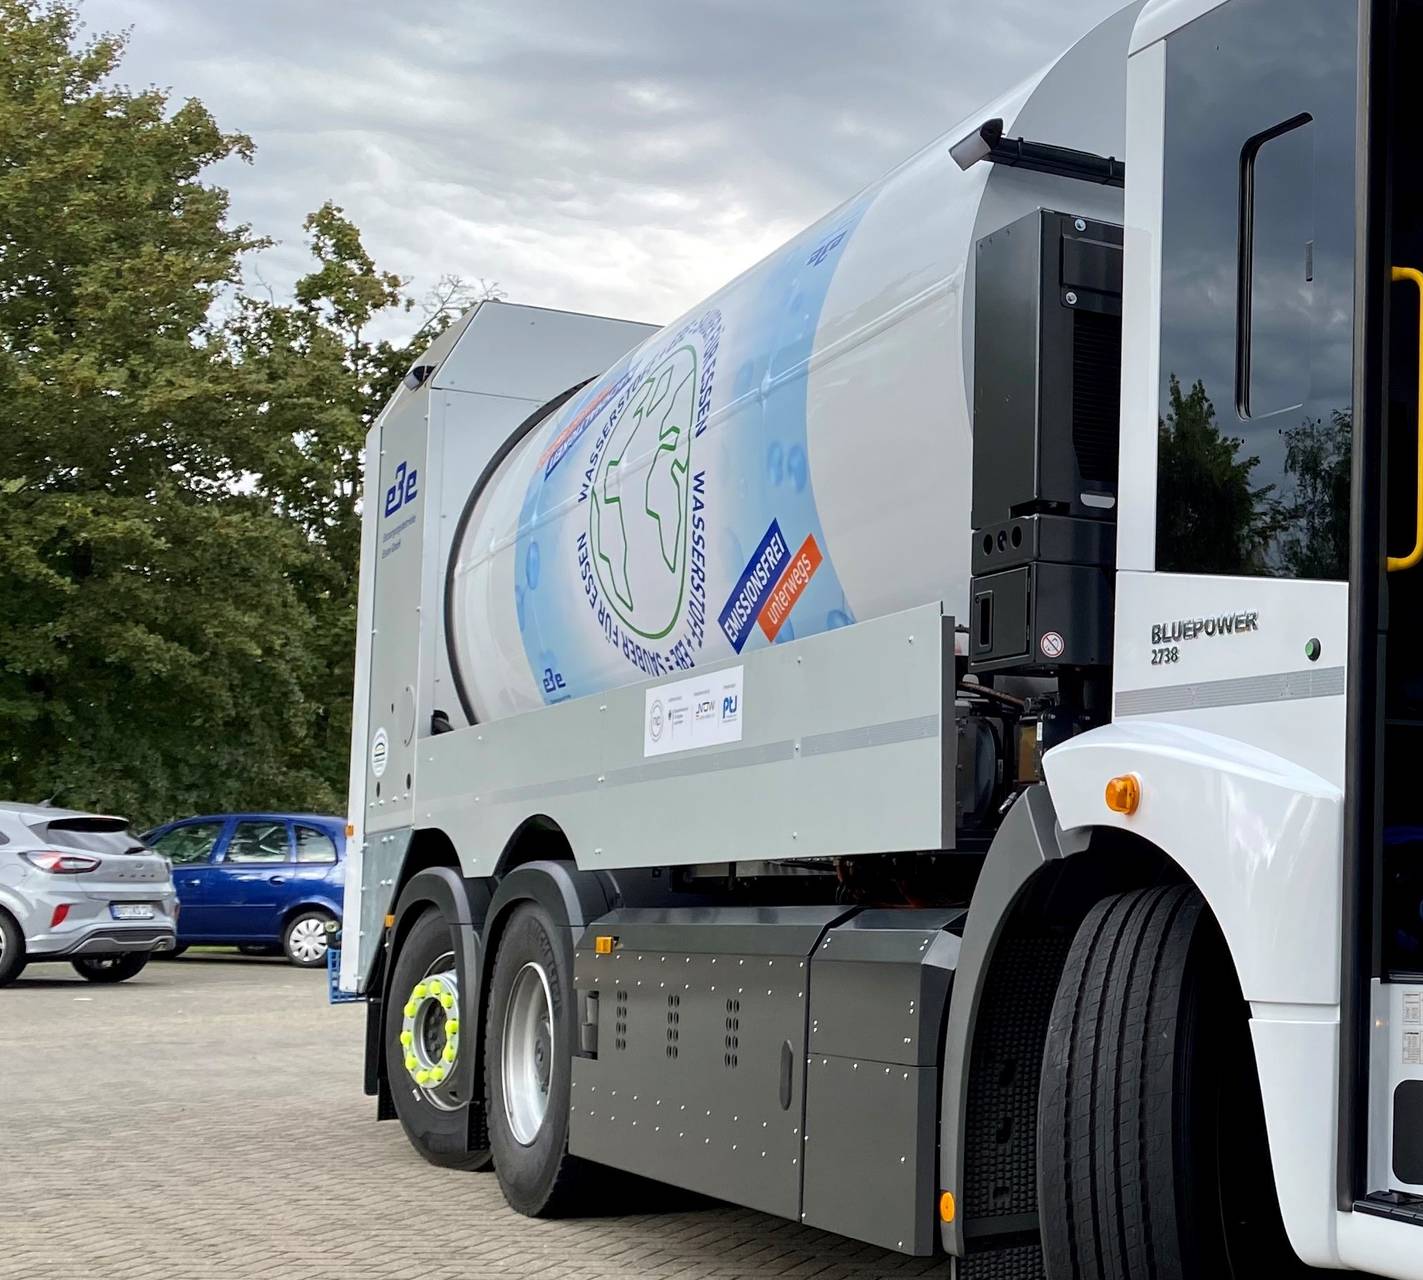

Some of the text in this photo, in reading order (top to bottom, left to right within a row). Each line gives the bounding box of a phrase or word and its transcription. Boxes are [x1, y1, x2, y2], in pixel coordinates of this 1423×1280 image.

[577, 532, 598, 609] ESSEN
[687, 471, 706, 648] WASSERSTOFF
[724, 532, 785, 643] EMISSIONSFREI
[767, 553, 811, 624] unterwegs
[598, 600, 618, 648] FÜR
[1151, 611, 1259, 645] BLUEPOWER
[621, 631, 667, 677] SAUBER
[1151, 646, 1179, 665] 2738
